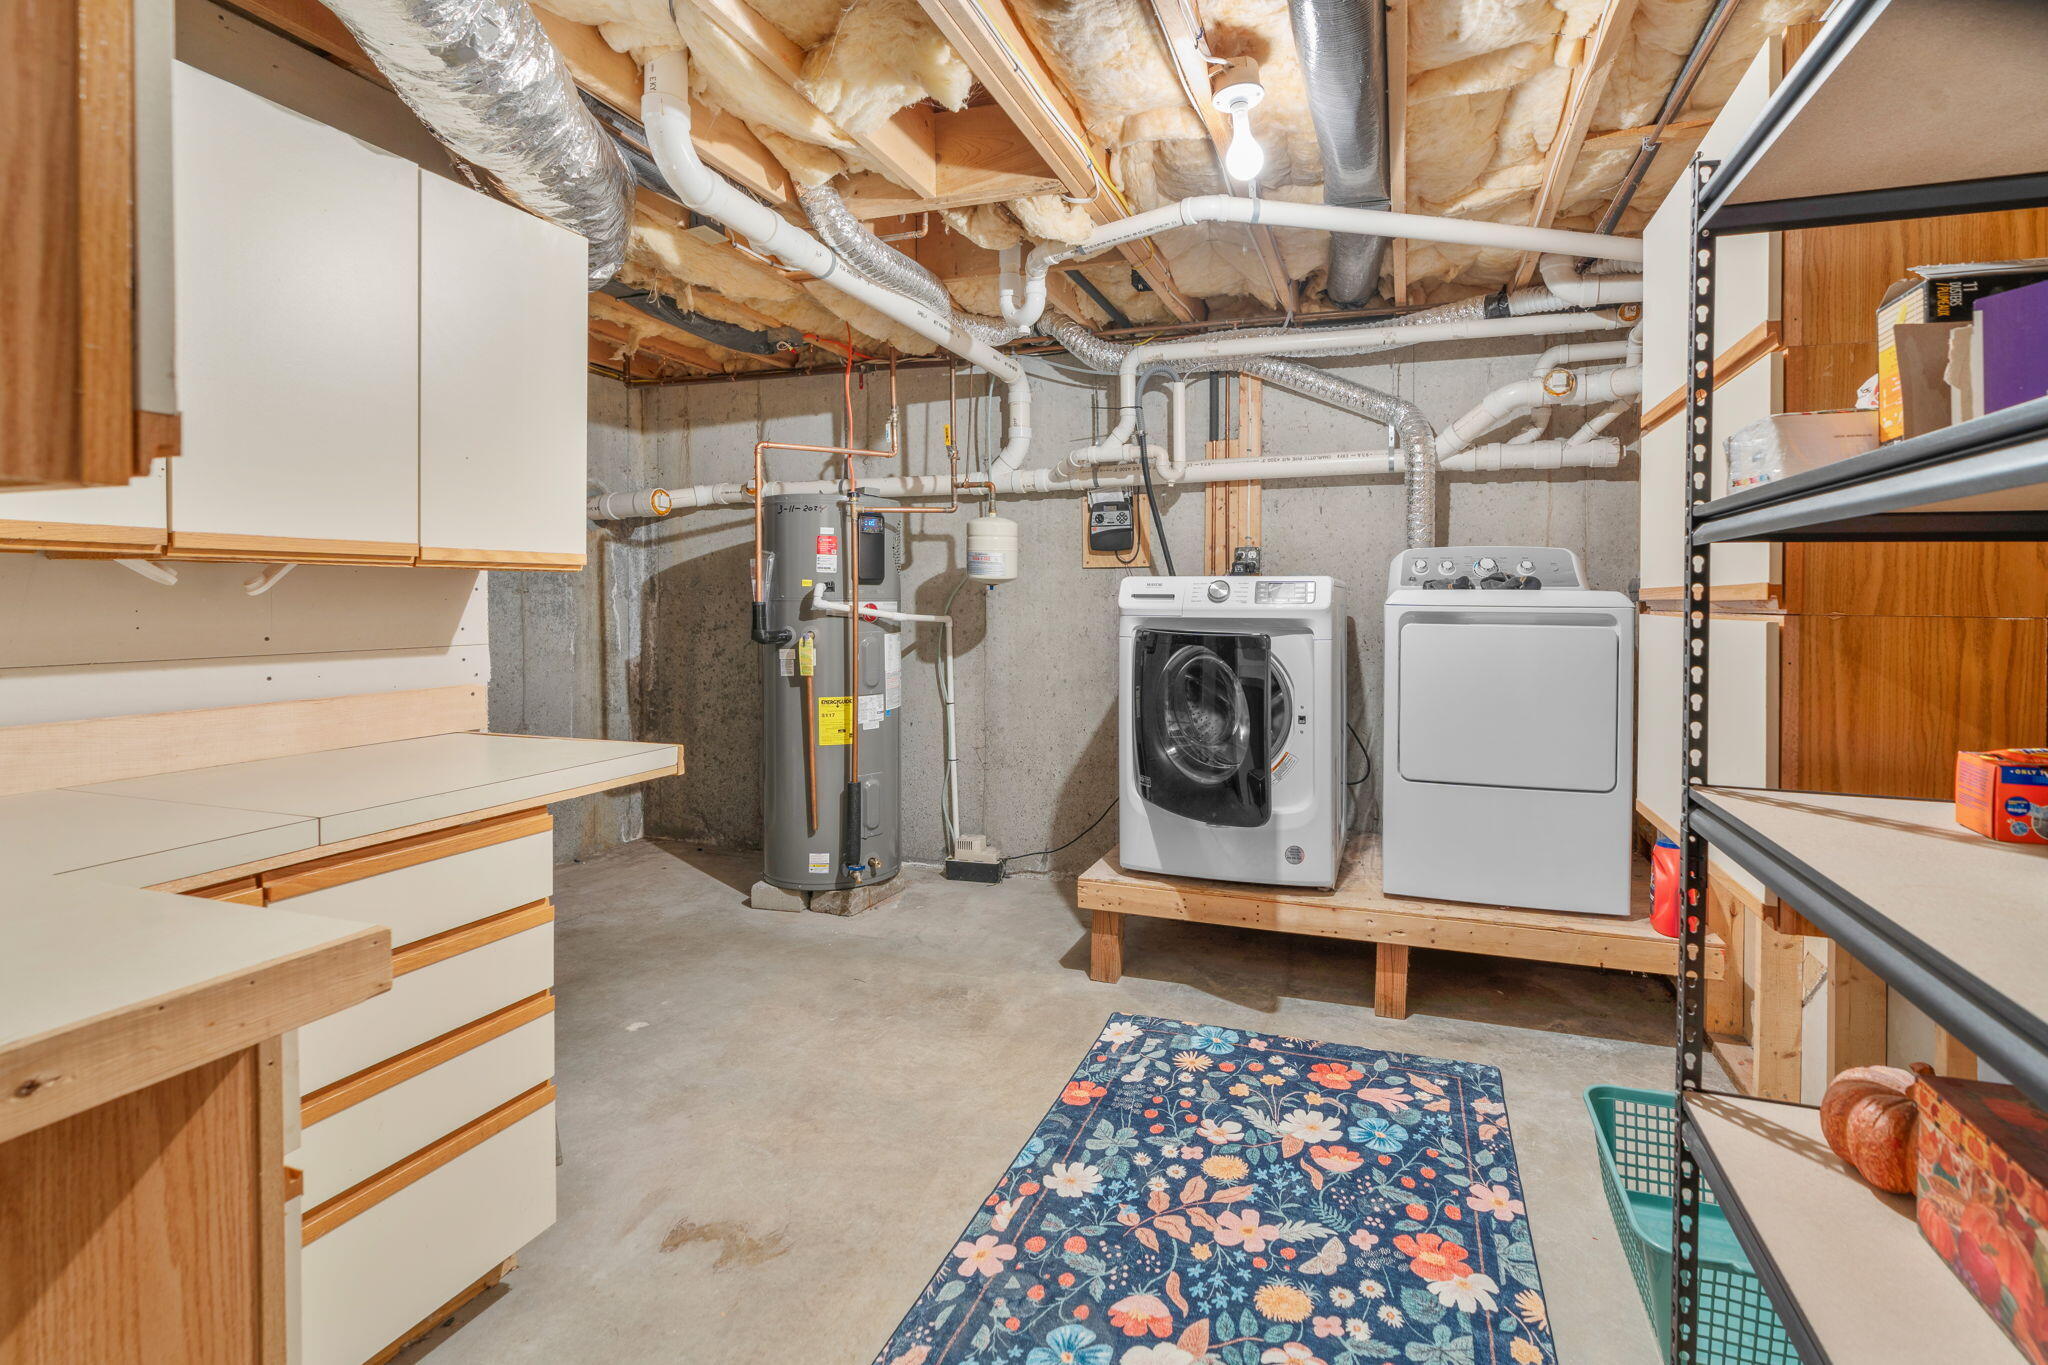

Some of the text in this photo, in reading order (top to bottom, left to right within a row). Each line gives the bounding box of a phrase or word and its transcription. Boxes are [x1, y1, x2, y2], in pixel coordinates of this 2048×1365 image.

[1962, 281, 1979, 291] 11
[1949, 281, 1963, 306] DUSTERS
[2014, 768, 2037, 776] ONLY
